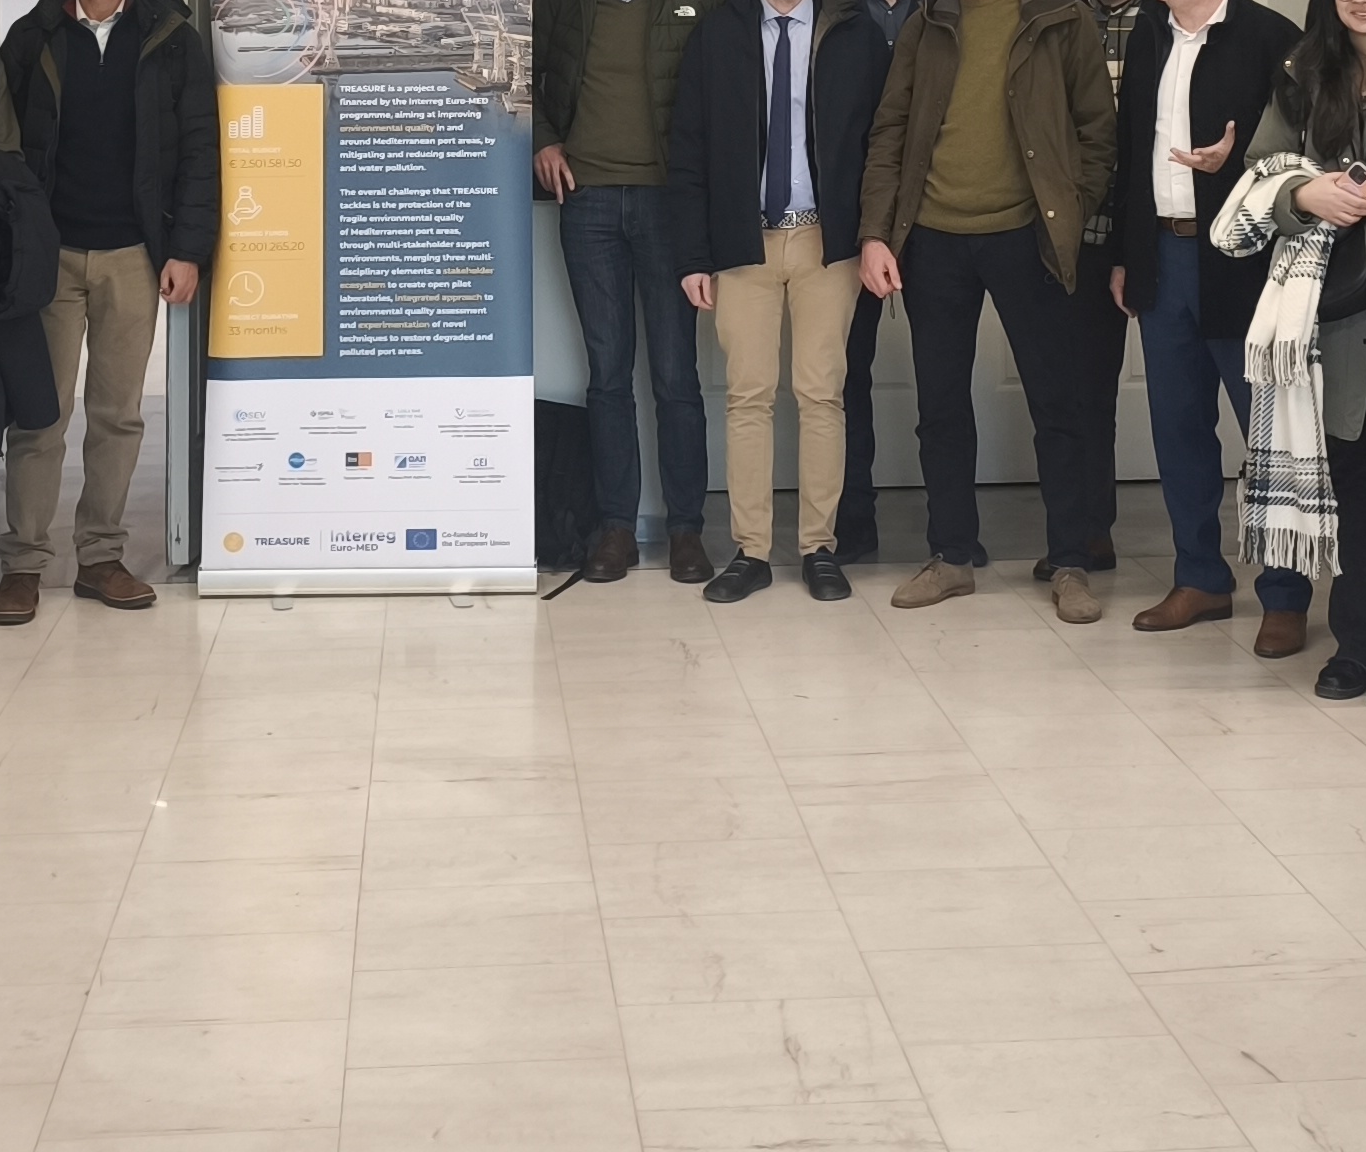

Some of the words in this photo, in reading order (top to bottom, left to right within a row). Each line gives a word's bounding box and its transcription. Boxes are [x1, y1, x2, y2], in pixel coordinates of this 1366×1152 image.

[404, 85, 435, 93] project
[340, 98, 377, 106] financed
[380, 98, 390, 106] by
[395, 111, 425, 120] aiming
[438, 110, 481, 119] improving
[485, 137, 496, 145] by
[406, 151, 444, 159] reducing
[446, 150, 487, 158] sediment
[340, 164, 356, 172] and
[388, 188, 431, 196] challenge
[373, 201, 380, 209] is
[382, 201, 396, 209] the
[398, 201, 443, 210] protection
[340, 215, 367, 223] fragile
[434, 214, 464, 223] quality
[340, 228, 349, 236] of
[415, 228, 434, 236] port
[340, 242, 375, 250] through
[456, 241, 490, 249] support
[404, 254, 440, 263] merging
[340, 268, 389, 277] disciplinary
[452, 281, 472, 289] pilot
[405, 308, 435, 316] quality
[443, 320, 466, 328] novel
[244, 325, 287, 335] months
[433, 334, 475, 342] degraded
[340, 348, 375, 357] polluted
[378, 348, 396, 356] port
[330, 530, 396, 544] Interreg
[255, 537, 310, 546] TREASURE
[330, 544, 378, 552] Euro-MED
